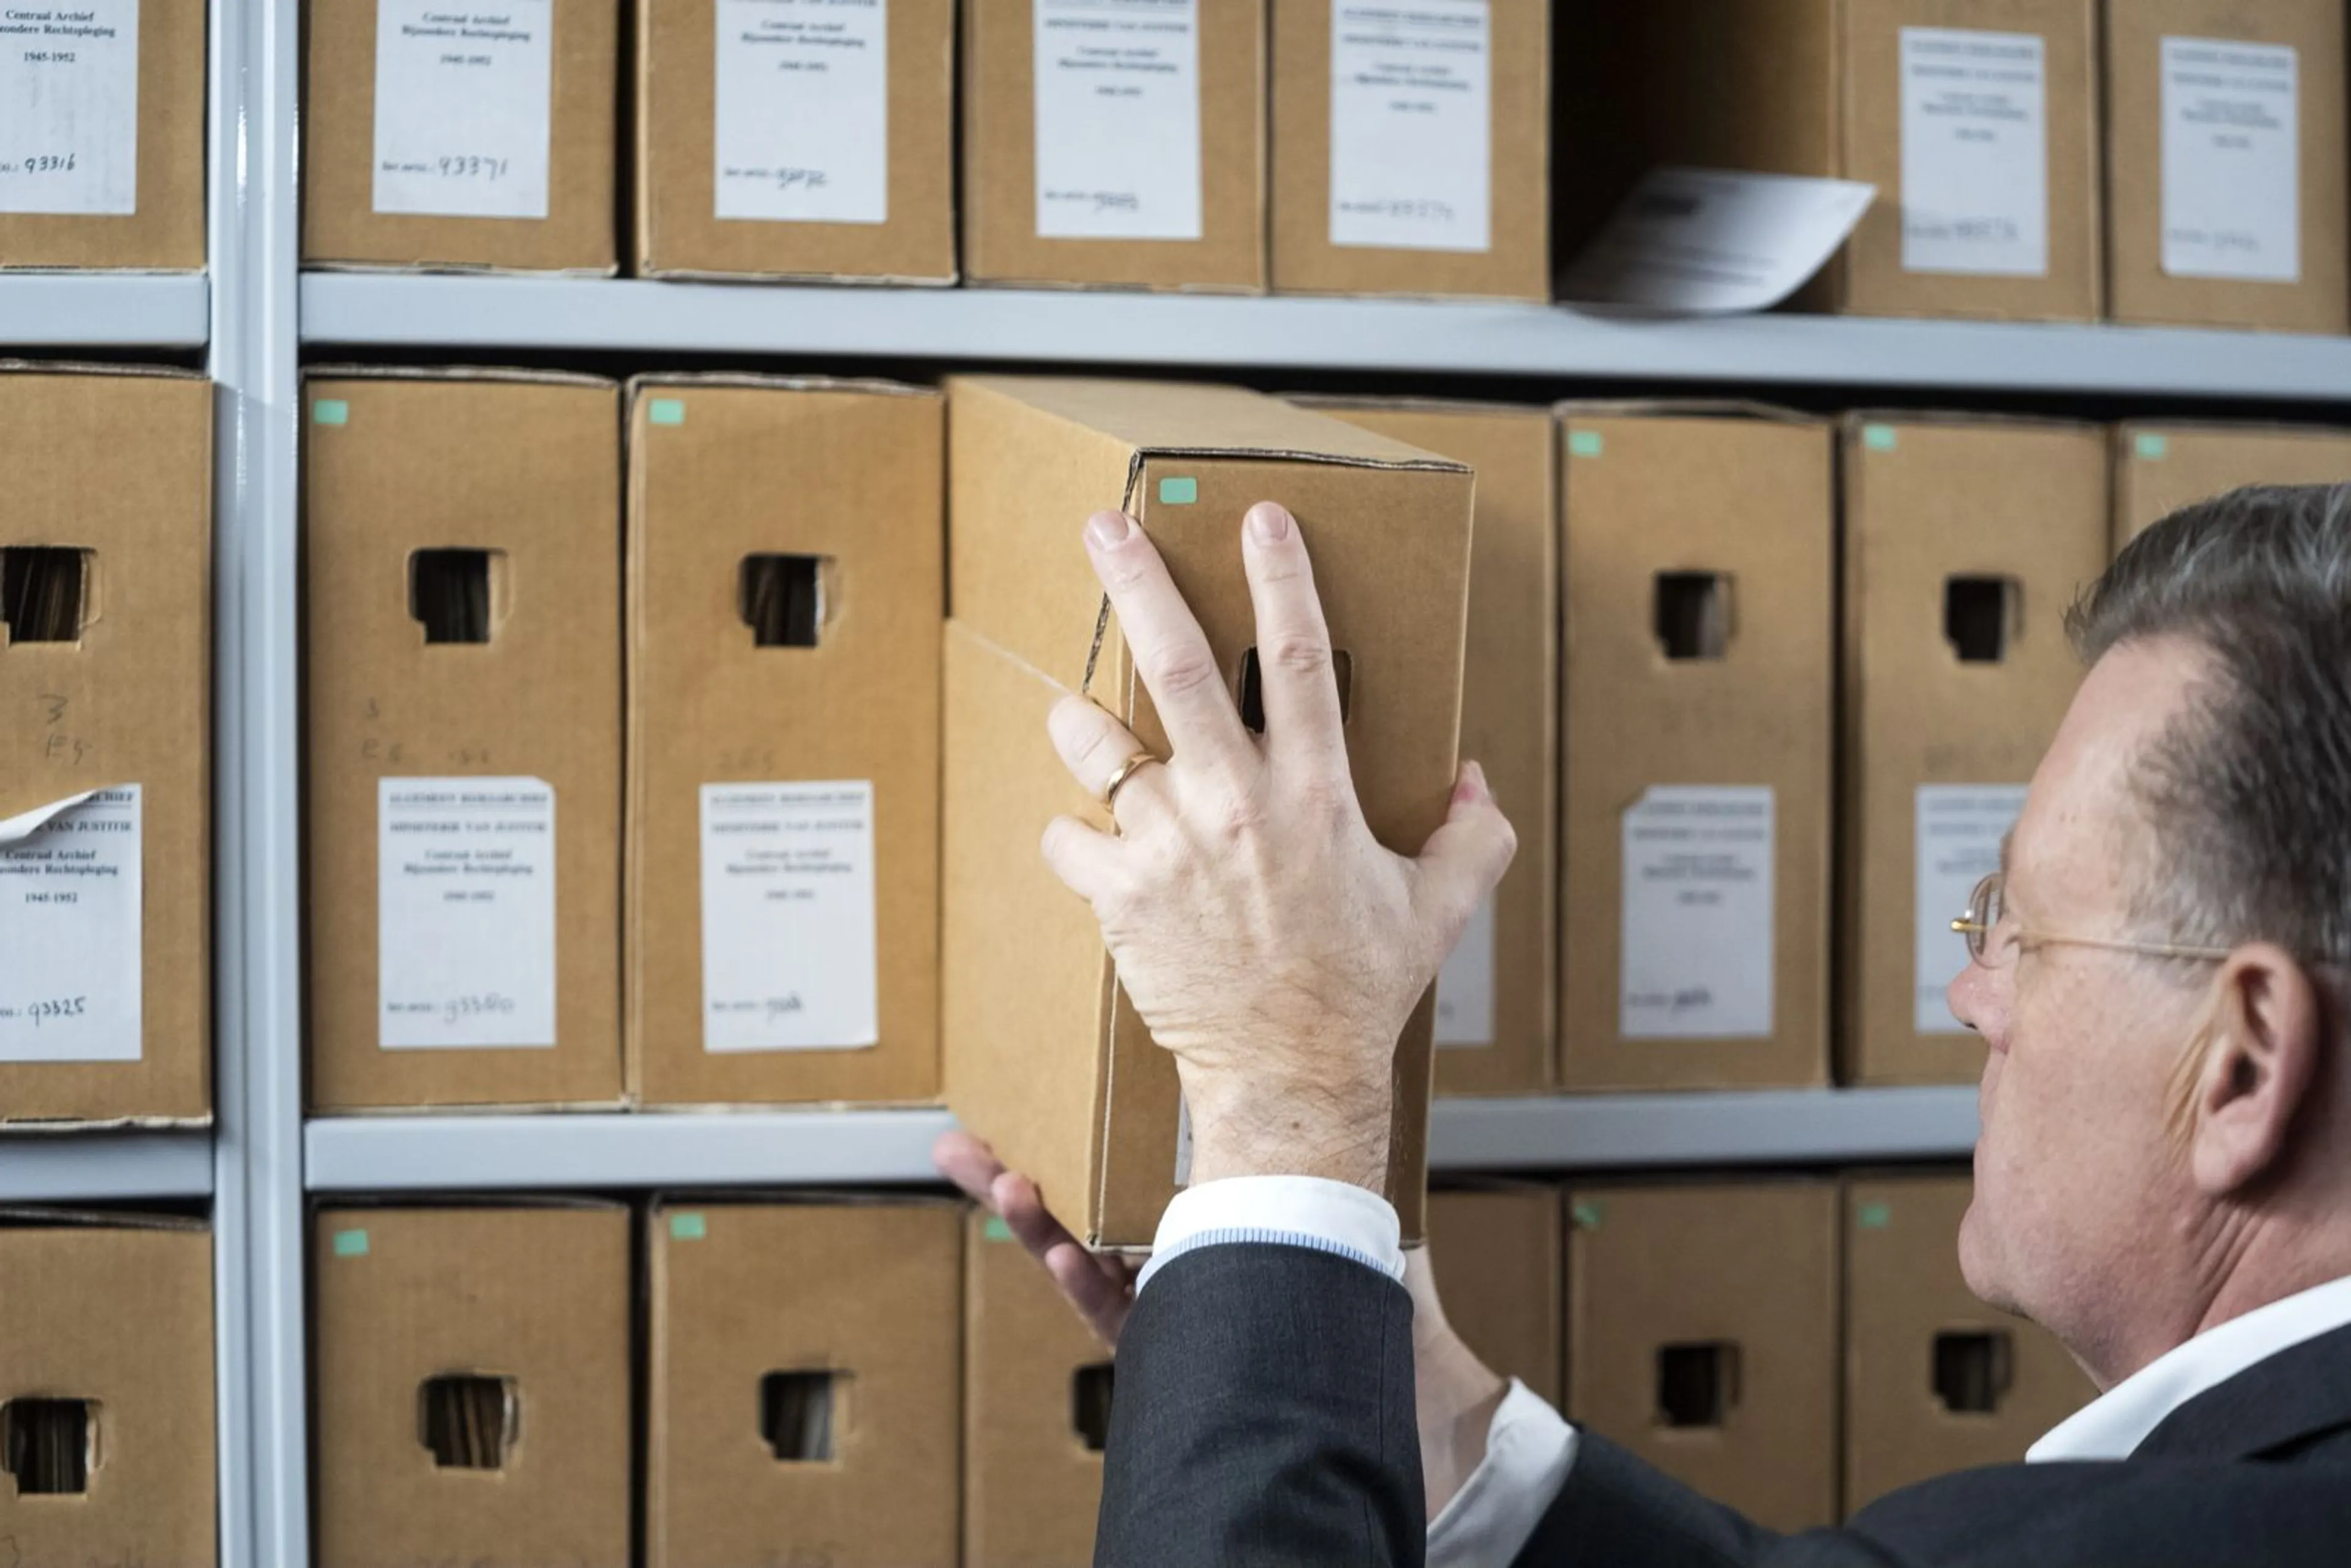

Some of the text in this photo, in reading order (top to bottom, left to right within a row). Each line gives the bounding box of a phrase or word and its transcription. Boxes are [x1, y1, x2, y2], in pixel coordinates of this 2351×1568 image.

[6, 10, 94, 21] Centraal Archief
[44, 24, 116, 37] Rechtspleging
[24, 152, 75, 174] 93316
[77, 820, 131, 831] JUSTITIE
[5, 849, 96, 860] Centraal Archief
